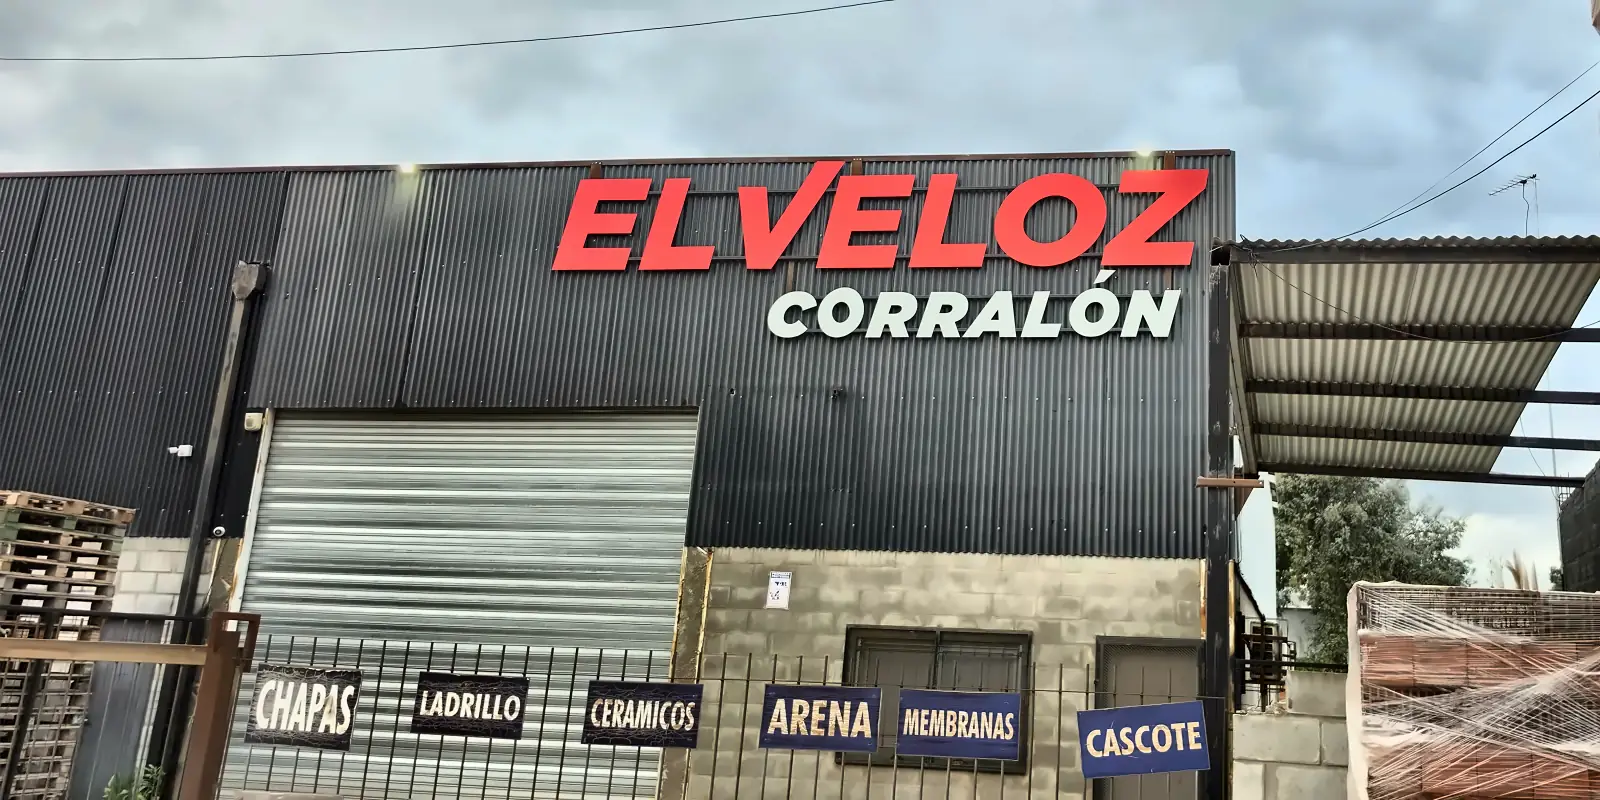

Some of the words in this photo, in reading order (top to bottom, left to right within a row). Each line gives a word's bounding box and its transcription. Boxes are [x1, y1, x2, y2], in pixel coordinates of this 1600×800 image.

[552, 177, 716, 271] EL
[738, 160, 1209, 270] VELOZ
[767, 269, 1181, 338] CORRALÓN
[255, 679, 356, 736] CHAPAS
[419, 689, 521, 722] LADRILLO
[590, 698, 696, 731] CERAMICOS
[767, 698, 872, 738] ARENA
[904, 708, 1014, 740] MEMBRANAS
[1086, 721, 1203, 758] CASCOTE
